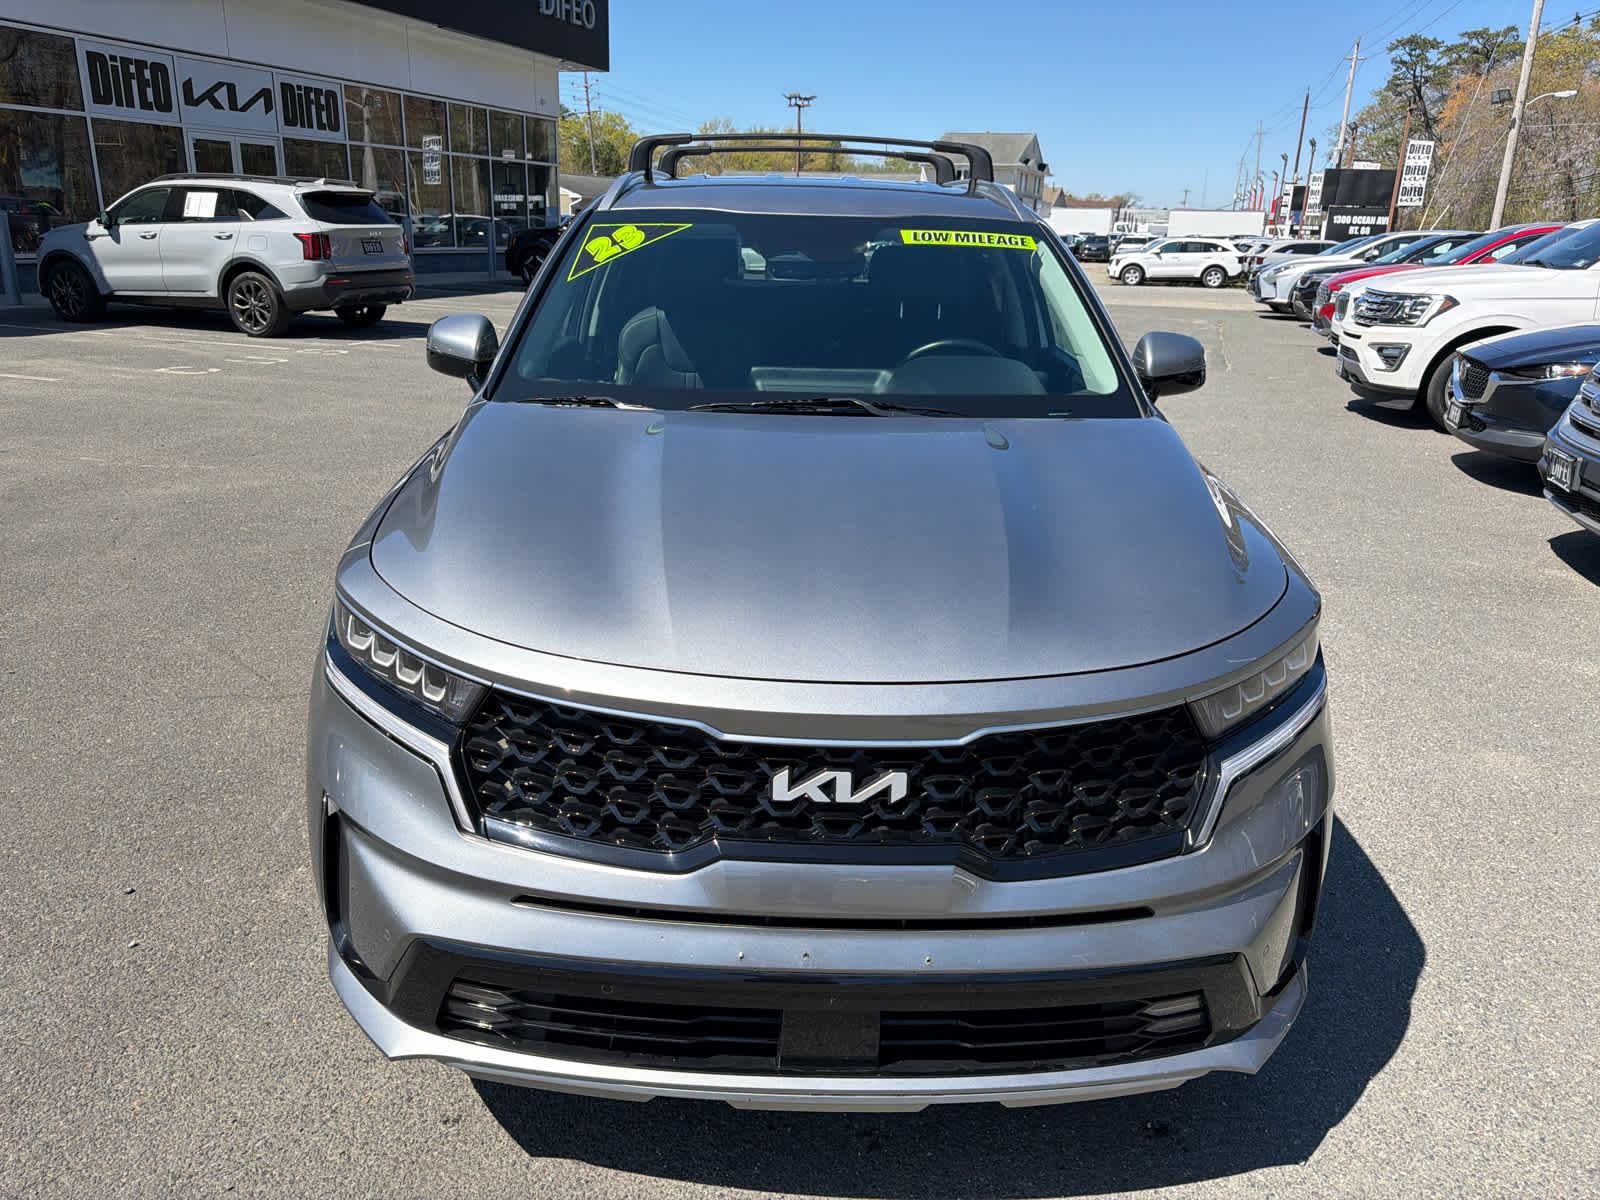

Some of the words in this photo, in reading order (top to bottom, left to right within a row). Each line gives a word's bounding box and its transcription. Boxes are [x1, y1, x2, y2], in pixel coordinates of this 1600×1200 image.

[183, 77, 274, 115] KIA
[1352, 215, 1376, 225] OCEAN
[585, 225, 646, 263] 23
[912, 231, 950, 242] LOW
[955, 233, 1029, 246] MILEAGE
[771, 768, 908, 804] KIA
